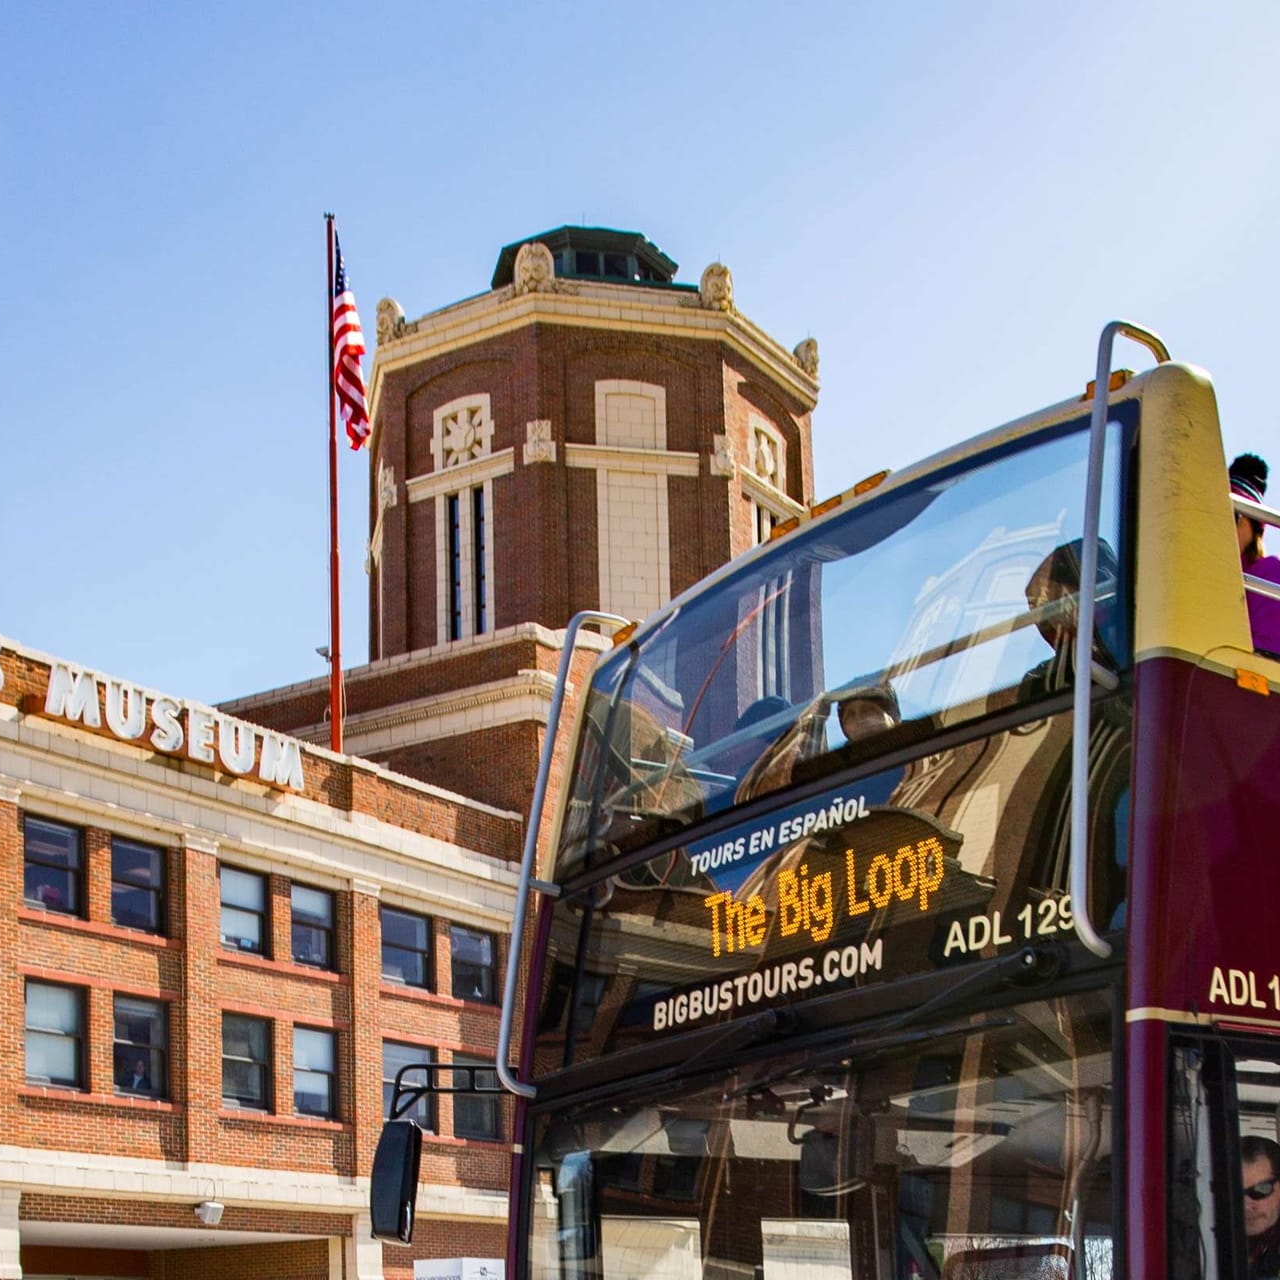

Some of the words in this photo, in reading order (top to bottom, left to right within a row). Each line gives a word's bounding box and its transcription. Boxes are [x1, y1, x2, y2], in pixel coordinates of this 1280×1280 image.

[45, 662, 305, 791] MUSEUM
[690, 834, 745, 877] TOURS
[749, 827, 775, 856] EN
[778, 795, 870, 844] ESPAÑOL
[704, 889, 766, 958] The
[777, 863, 832, 943] Big
[845, 836, 945, 918] Loop
[943, 913, 1012, 957] ADL
[1016, 893, 1075, 940] 129
[653, 939, 883, 1032] BIGBUSTOURS.COM
[1208, 966, 1267, 1010] ADL
